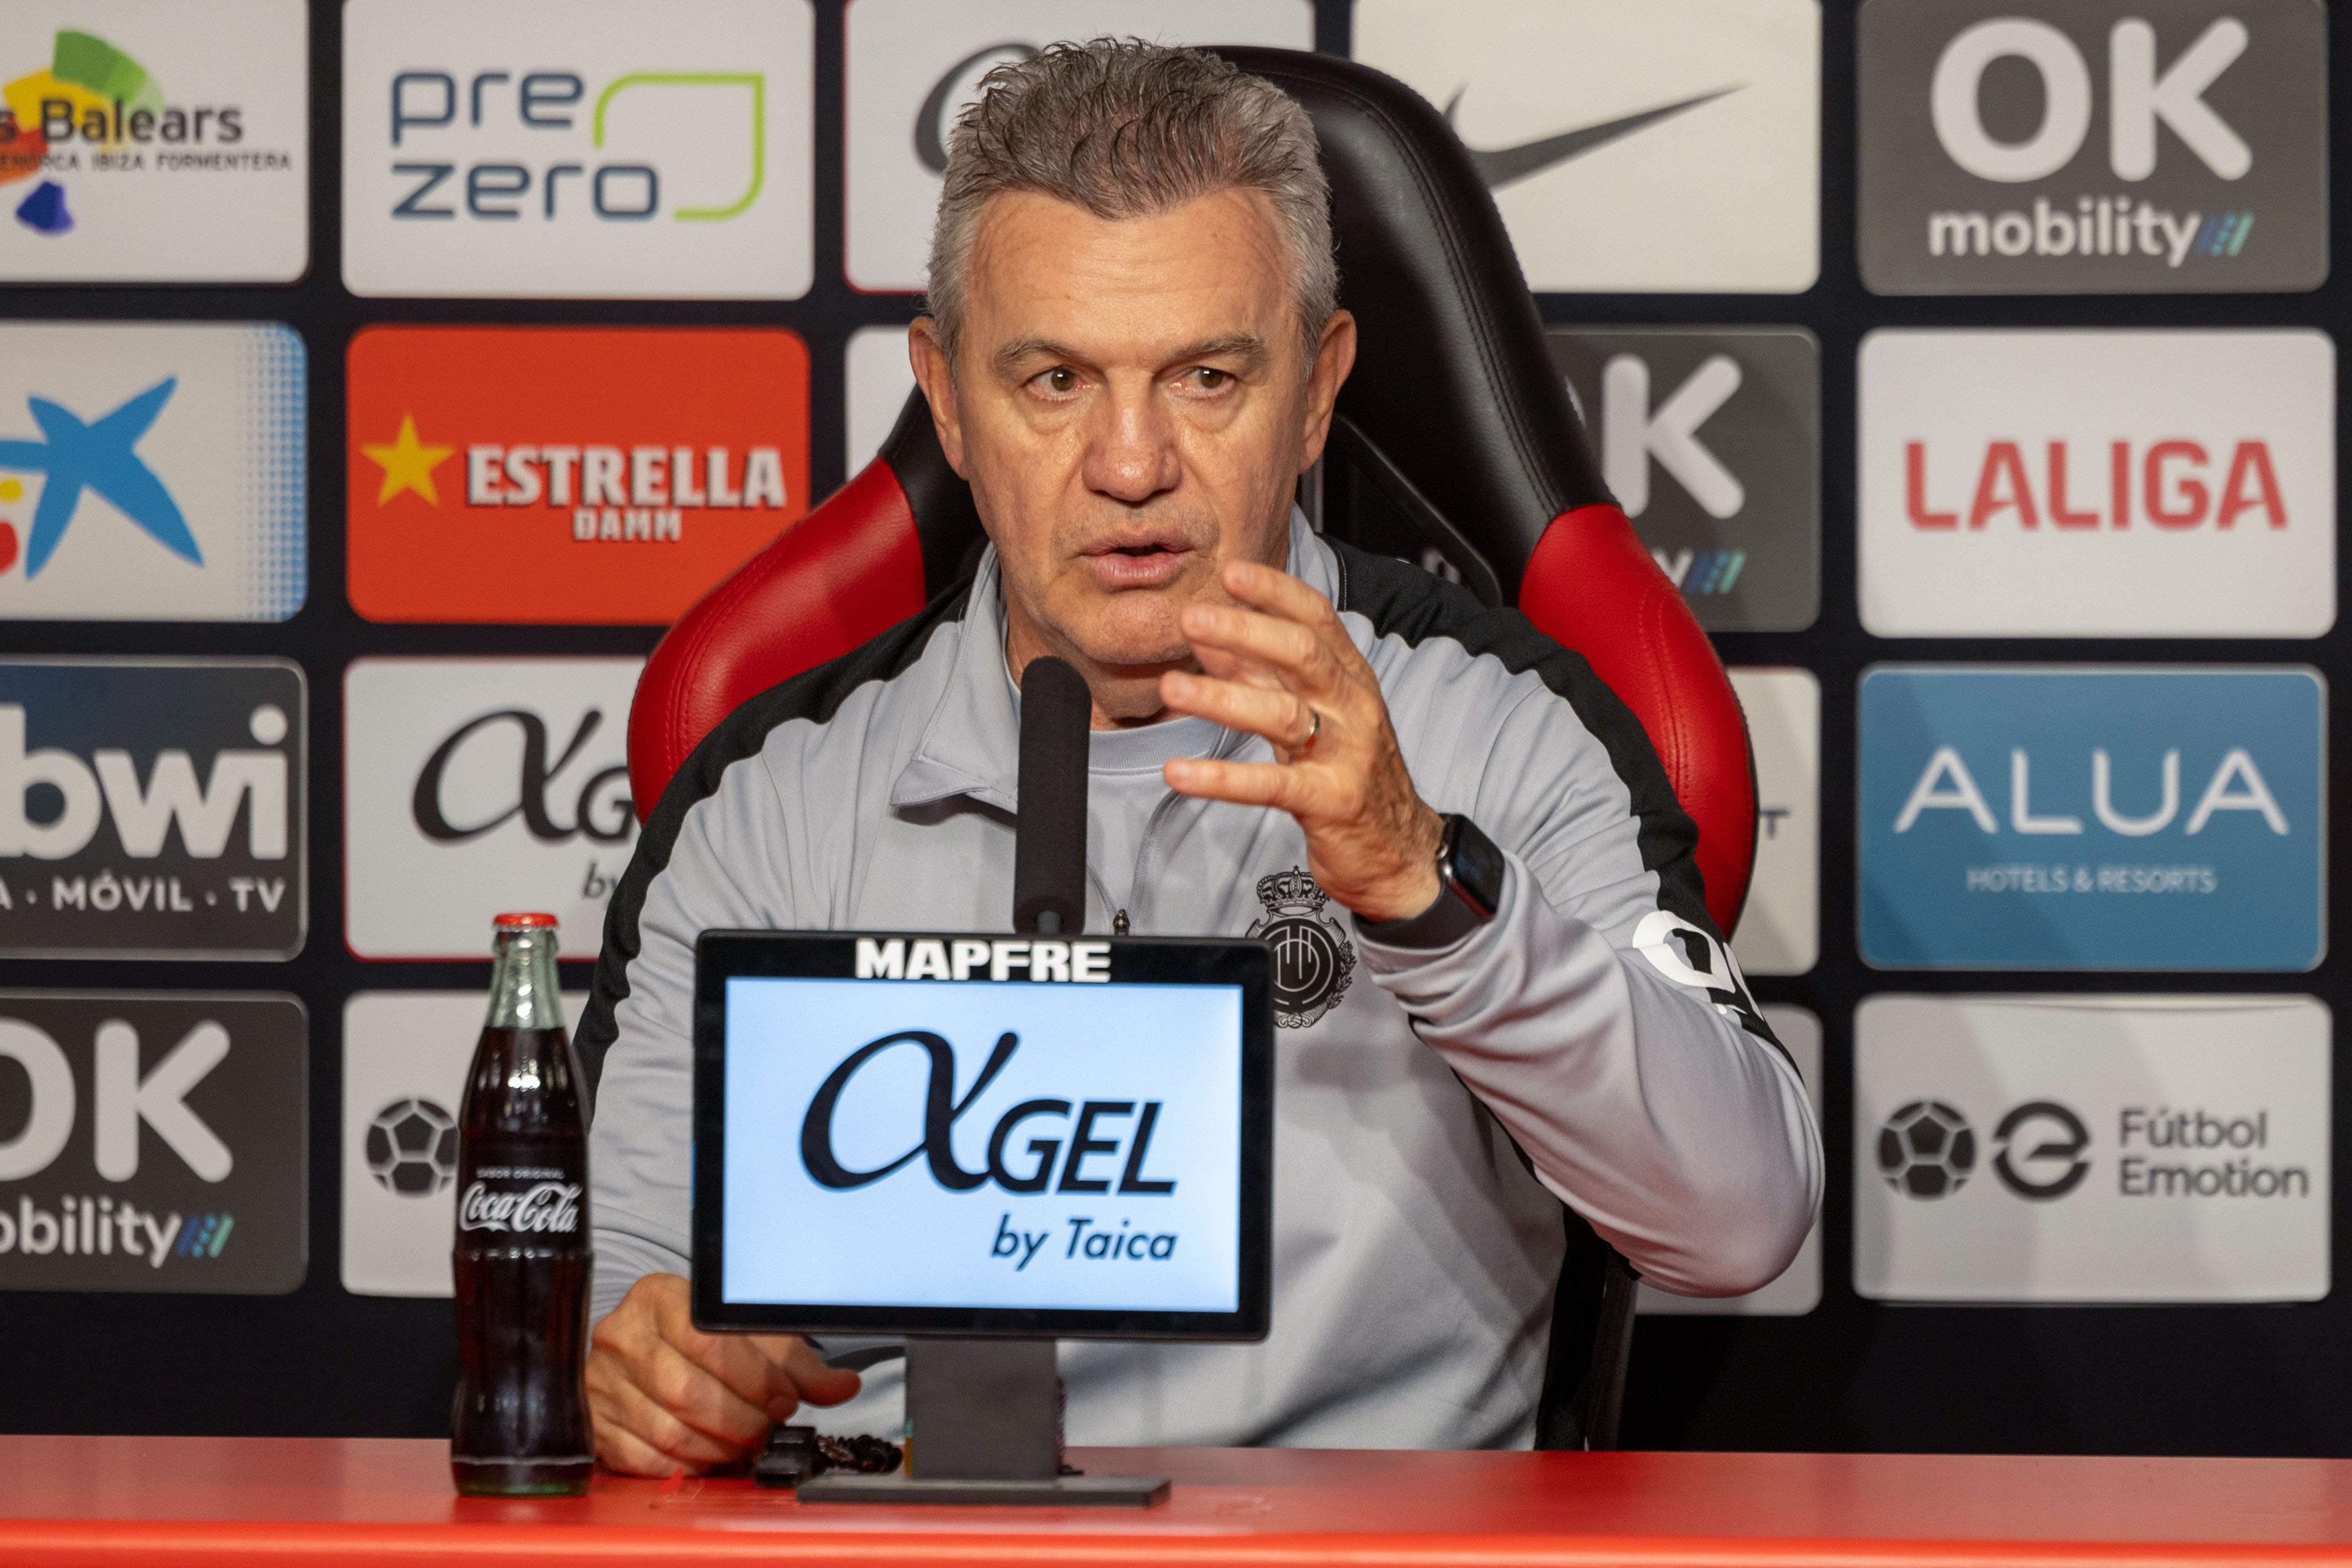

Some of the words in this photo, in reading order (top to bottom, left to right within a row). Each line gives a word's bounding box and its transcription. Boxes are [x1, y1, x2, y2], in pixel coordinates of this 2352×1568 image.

[41, 97, 244, 144] Balears
[391, 70, 585, 148] pre
[1931, 18, 2252, 182] OK
[91, 152, 144, 171] IBIZA
[392, 163, 659, 221] zero
[1929, 197, 2201, 269] mobility
[467, 444, 787, 508] ESTRELLA
[1905, 439, 2288, 531] LALIGA
[573, 508, 683, 541] DAMM
[1894, 746, 2289, 837] ALUA
[52, 870, 193, 911] MÓVIL
[230, 877, 286, 912] TV
[1967, 864, 2069, 894] HOTELS
[2072, 865, 2094, 894] &
[2096, 865, 2217, 895] RESORTS
[855, 938, 1111, 983] MAPFRE
[2118, 1105, 2267, 1149] Fútbol
[2118, 1154, 2310, 1198] Emotion
[991, 1213, 1048, 1272] by
[1067, 1217, 1178, 1261] Taica
